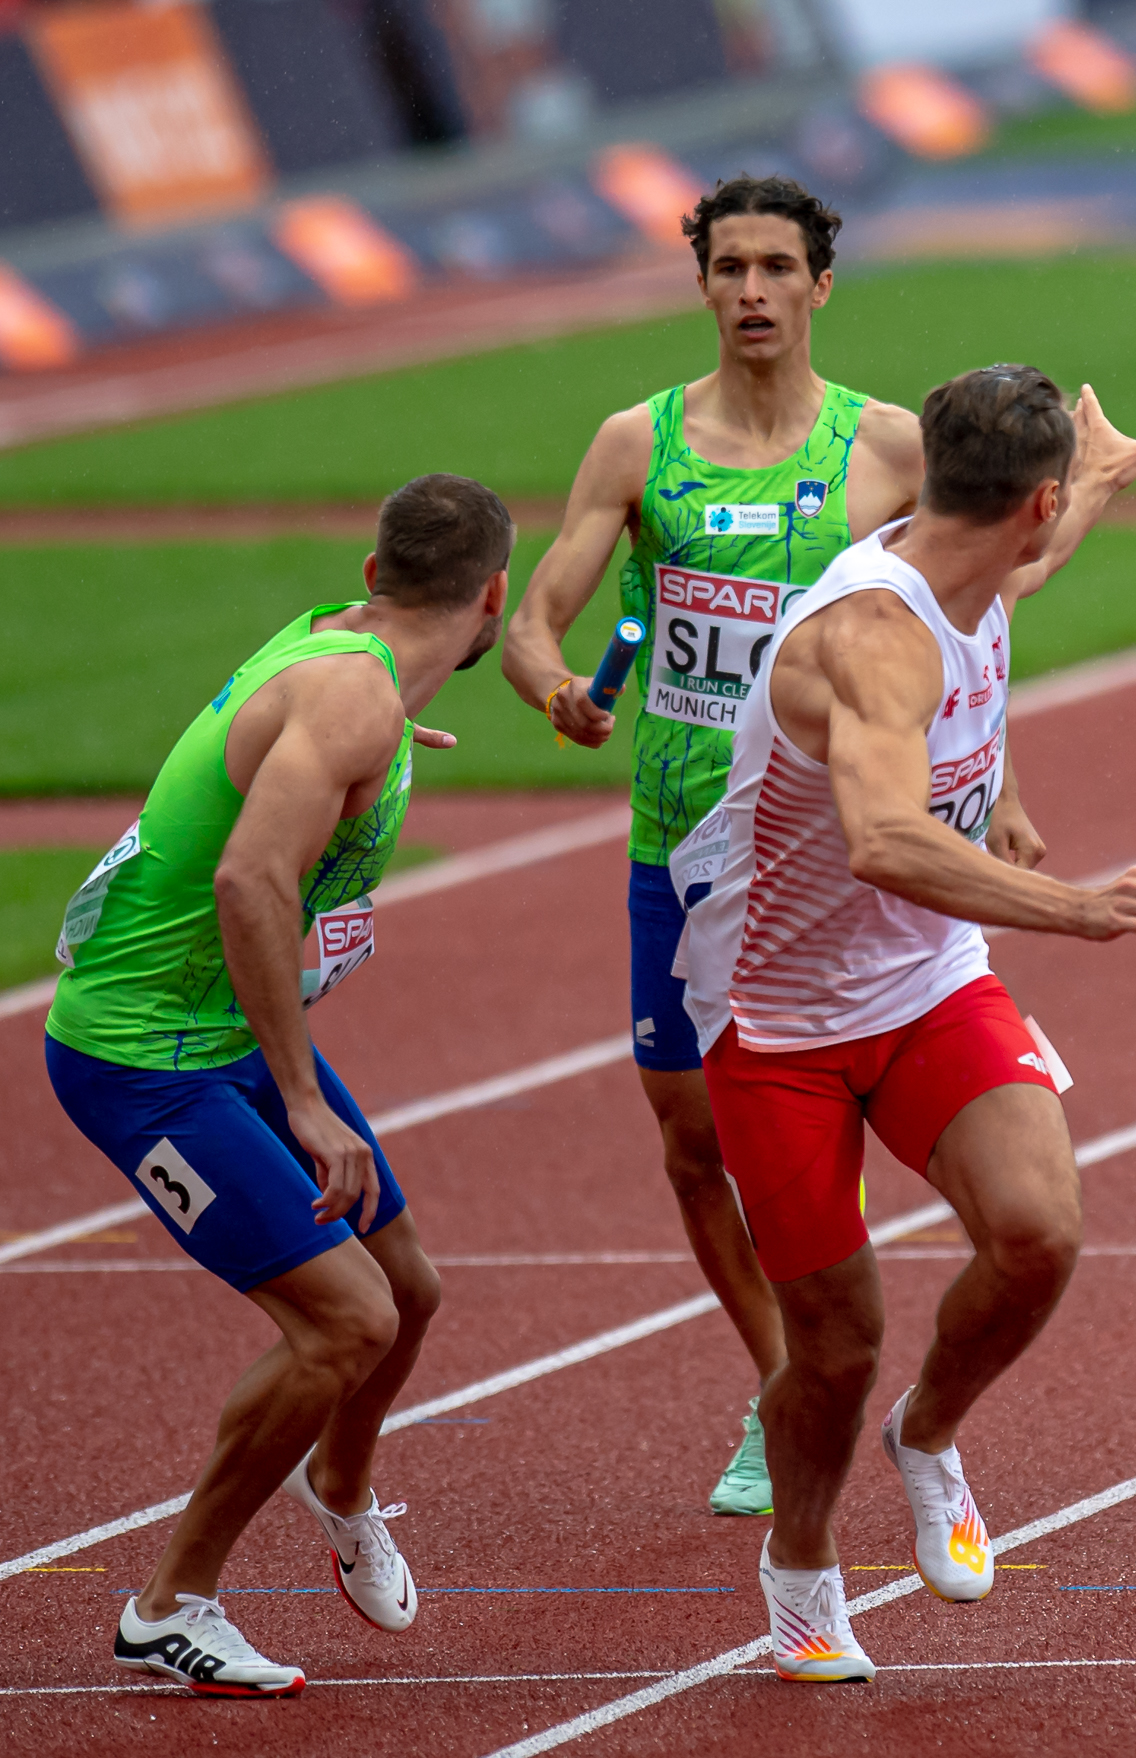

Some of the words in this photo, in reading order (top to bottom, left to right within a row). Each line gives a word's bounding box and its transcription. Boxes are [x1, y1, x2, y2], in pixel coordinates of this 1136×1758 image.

[739, 521, 776, 530] Slovenije
[662, 573, 775, 618] SPAR
[656, 688, 737, 724] MUNICH
[680, 675, 686, 688] I
[687, 678, 718, 693] RUN
[722, 683, 751, 698] CLE
[931, 733, 1000, 794] SPAR
[324, 916, 373, 951] SPA
[150, 1166, 190, 1214] 3
[163, 1633, 226, 1682] AIR
